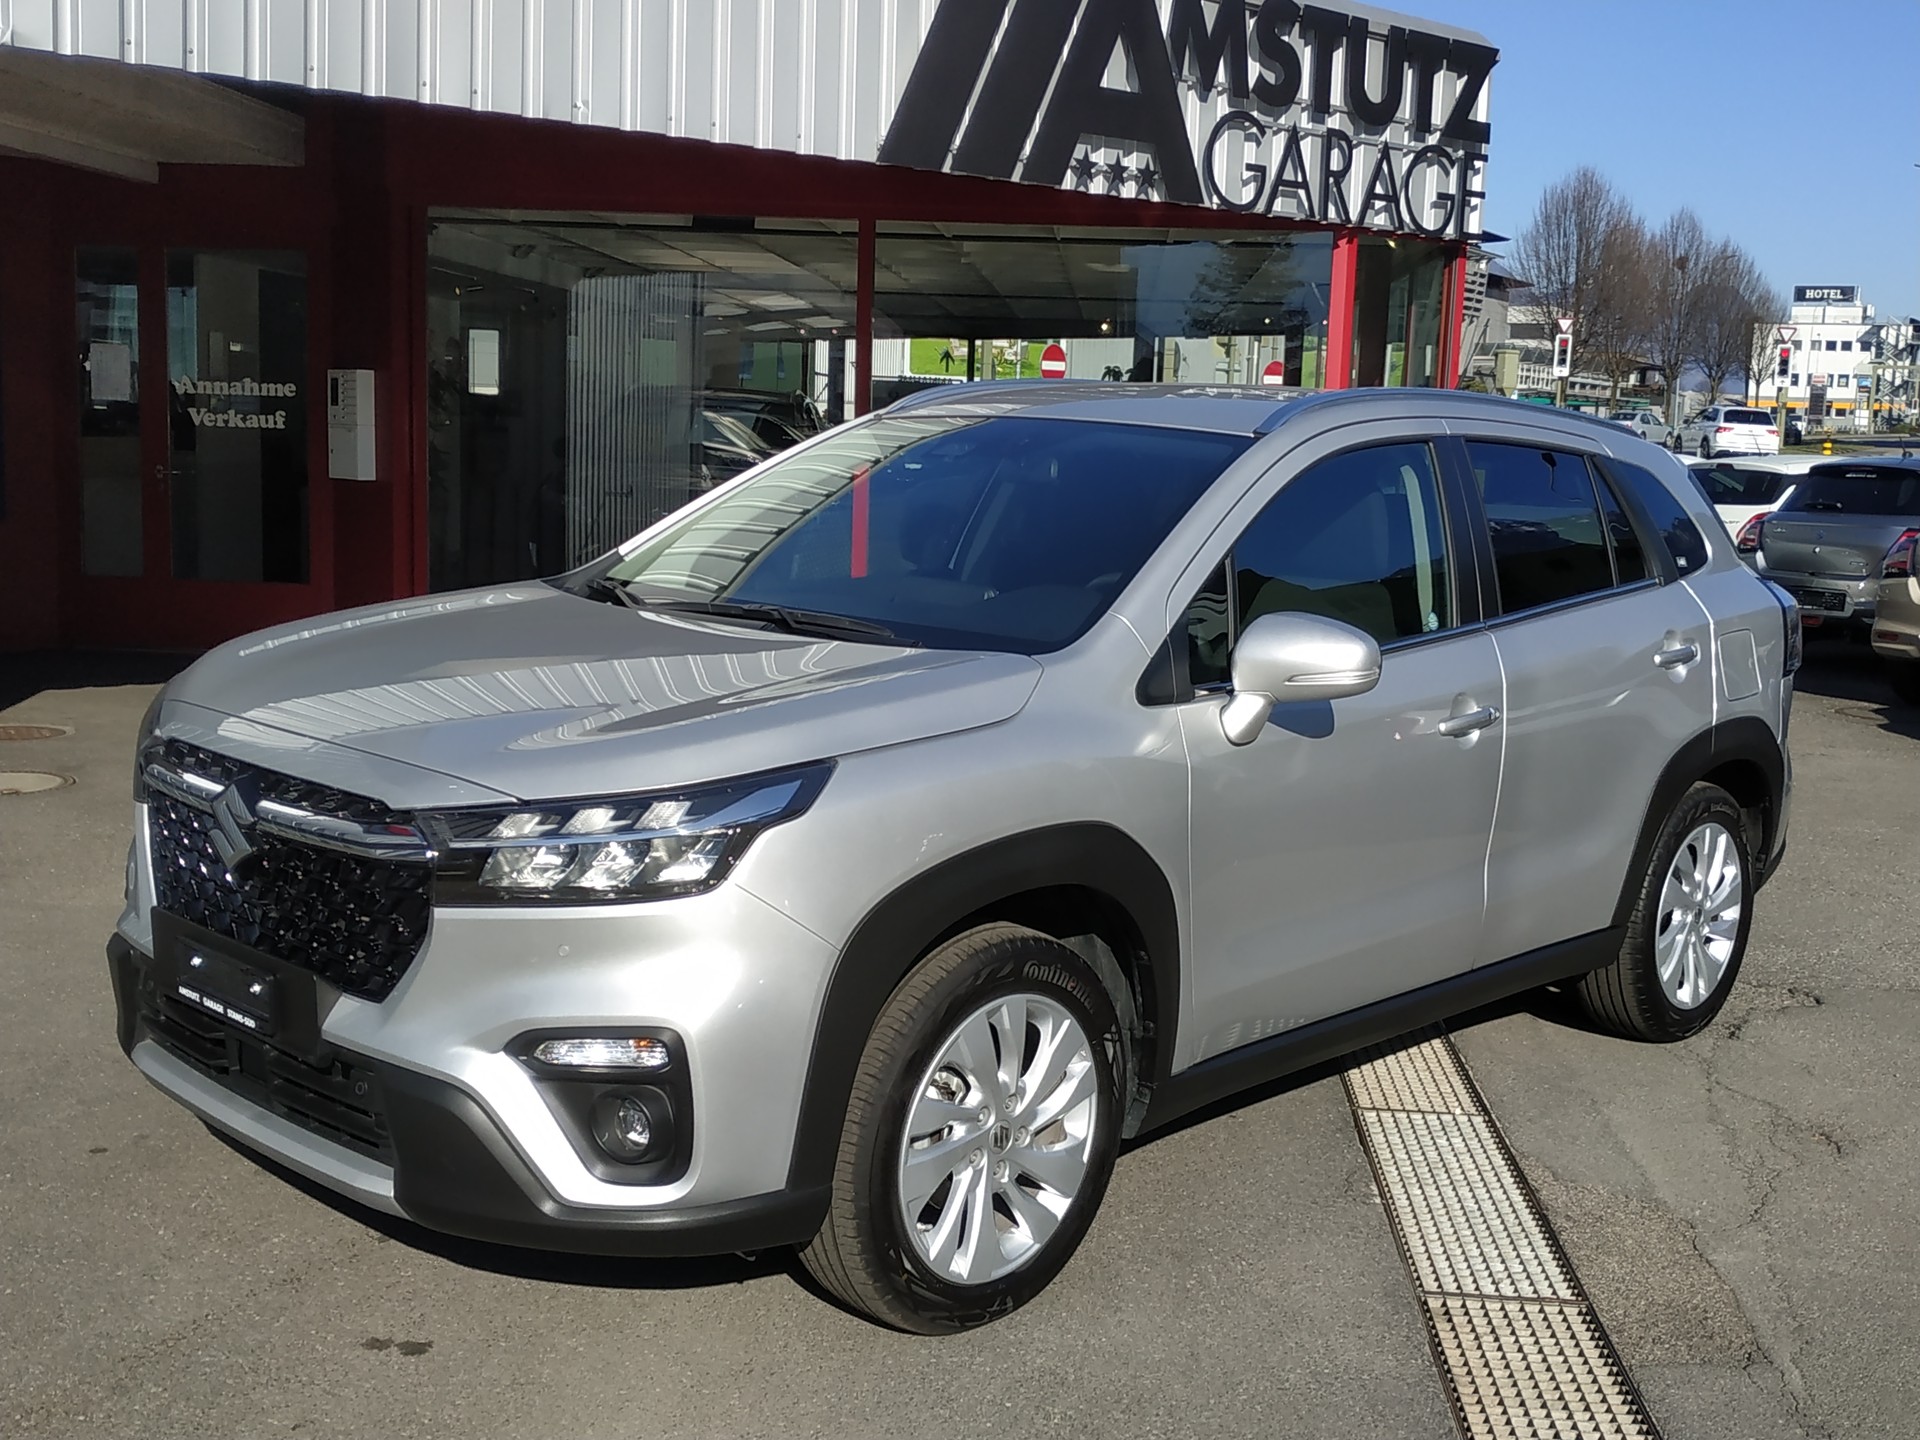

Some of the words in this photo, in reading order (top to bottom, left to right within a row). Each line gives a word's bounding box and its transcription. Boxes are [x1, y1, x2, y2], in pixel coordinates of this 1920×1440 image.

[1203, 110, 1489, 241] GARAGE
[1804, 289, 1843, 299] HOTEL
[179, 375, 296, 397] Annahme
[187, 407, 286, 428] Verkauf
[202, 996, 224, 1013] GARAGE
